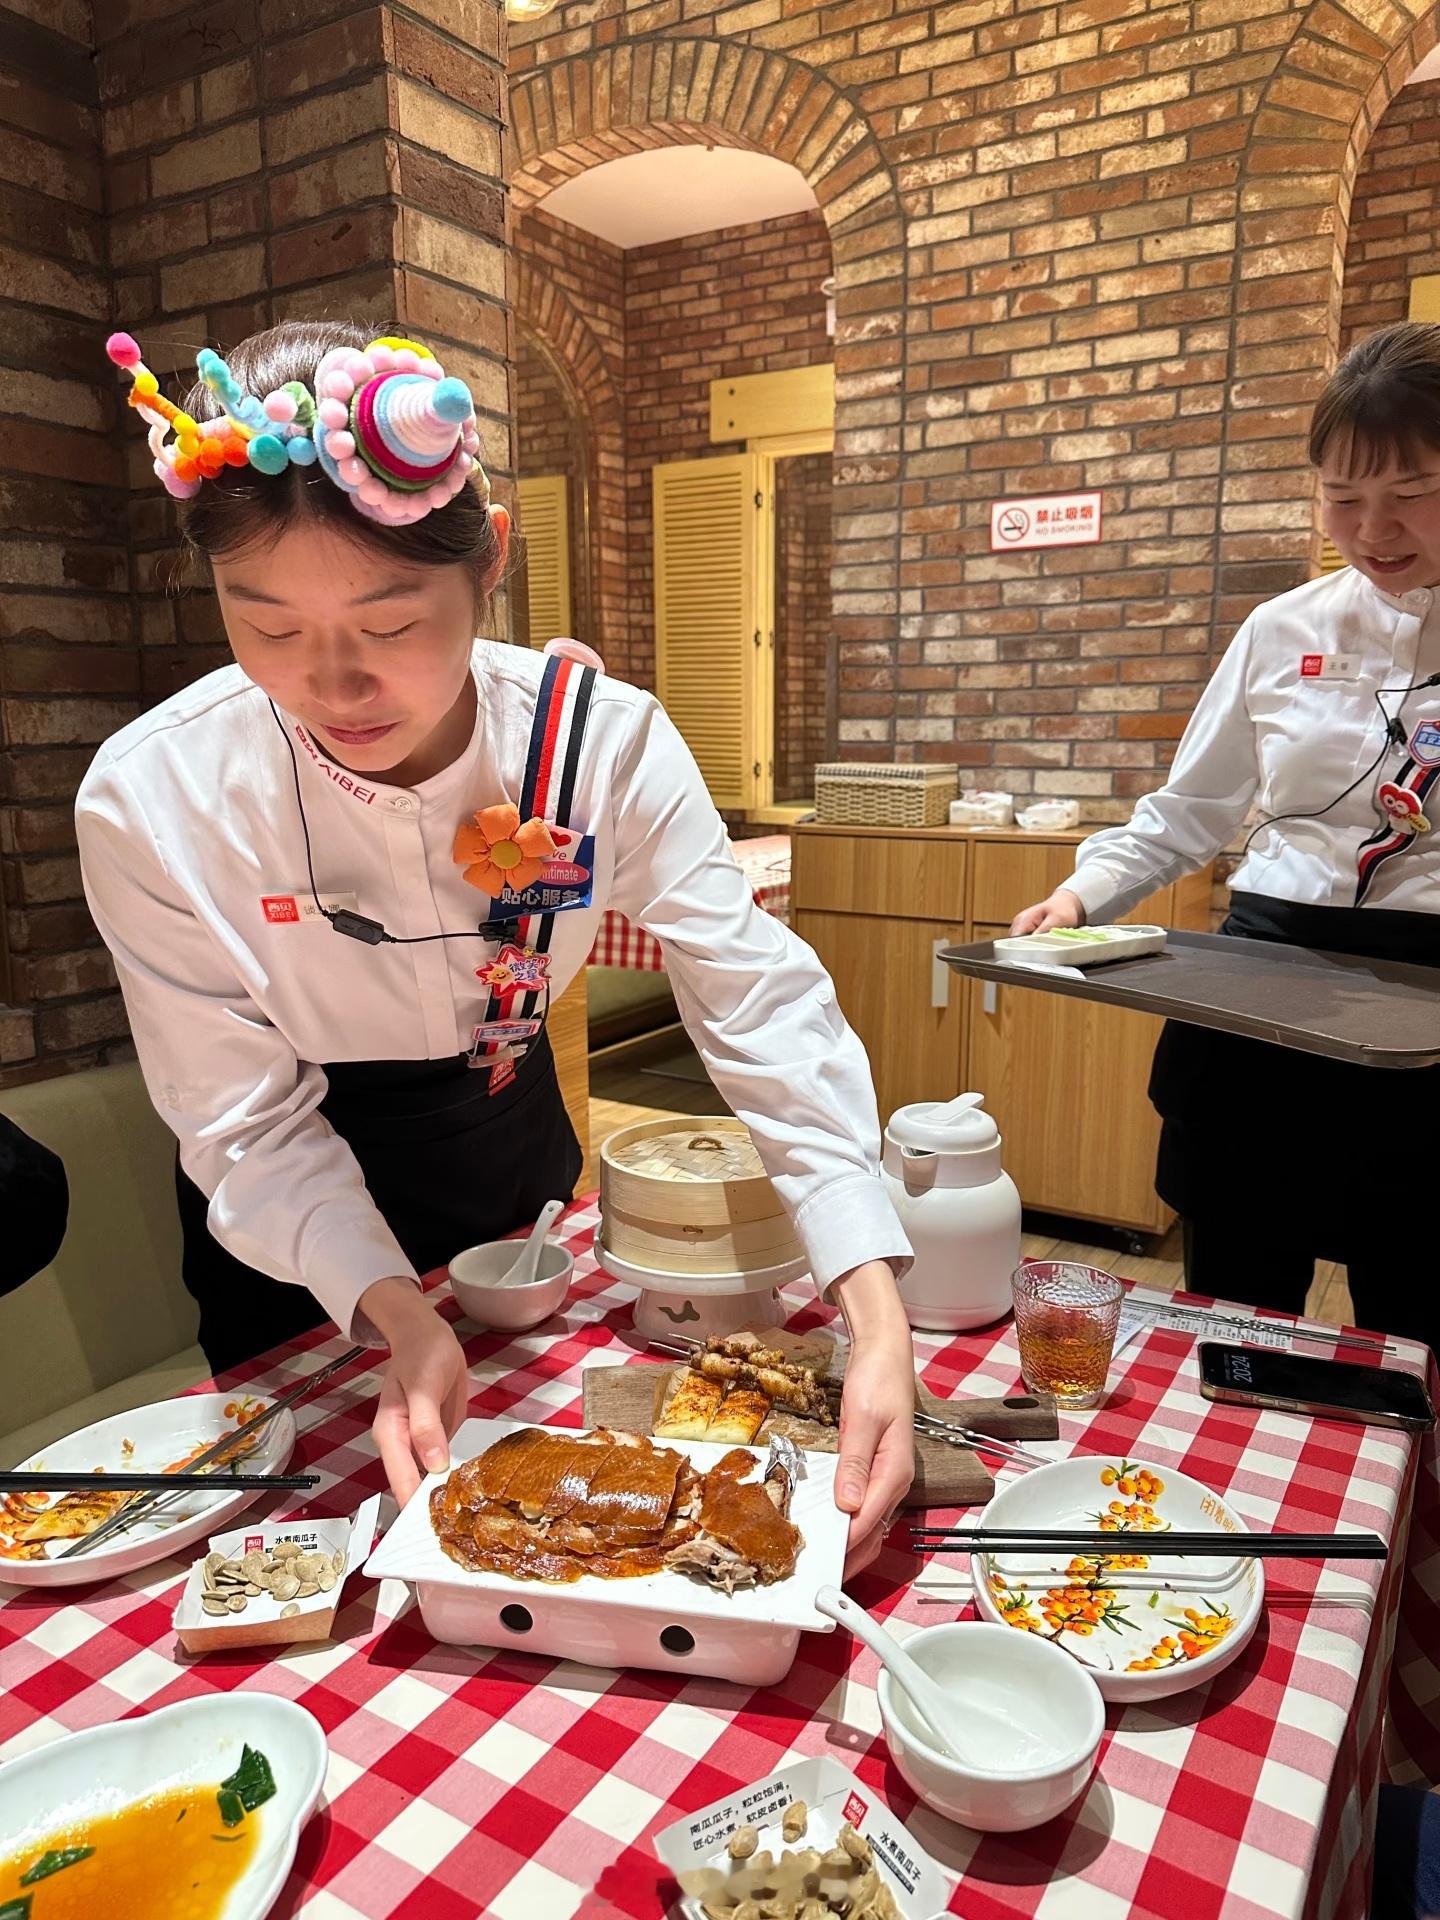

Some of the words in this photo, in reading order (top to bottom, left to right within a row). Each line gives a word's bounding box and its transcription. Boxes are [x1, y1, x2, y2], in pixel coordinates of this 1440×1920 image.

[1037, 505, 1093, 523] 禁止吸烟
[1035, 527, 1049, 535] NO
[318, 763, 377, 805] XIBEI
[501, 887, 580, 906] 贴心服务
[267, 902, 292, 912] 西贝
[271, 911, 295, 919] XIBEI
[509, 958, 538, 973] 微笑
[515, 968, 537, 981] 之星
[1231, 1355, 1253, 1384] 20:24
[247, 1539, 262, 1547] 西贝
[275, 1533, 317, 1544] 水煮南瓜子
[879, 1832, 922, 1880] 水煮南瓜子
